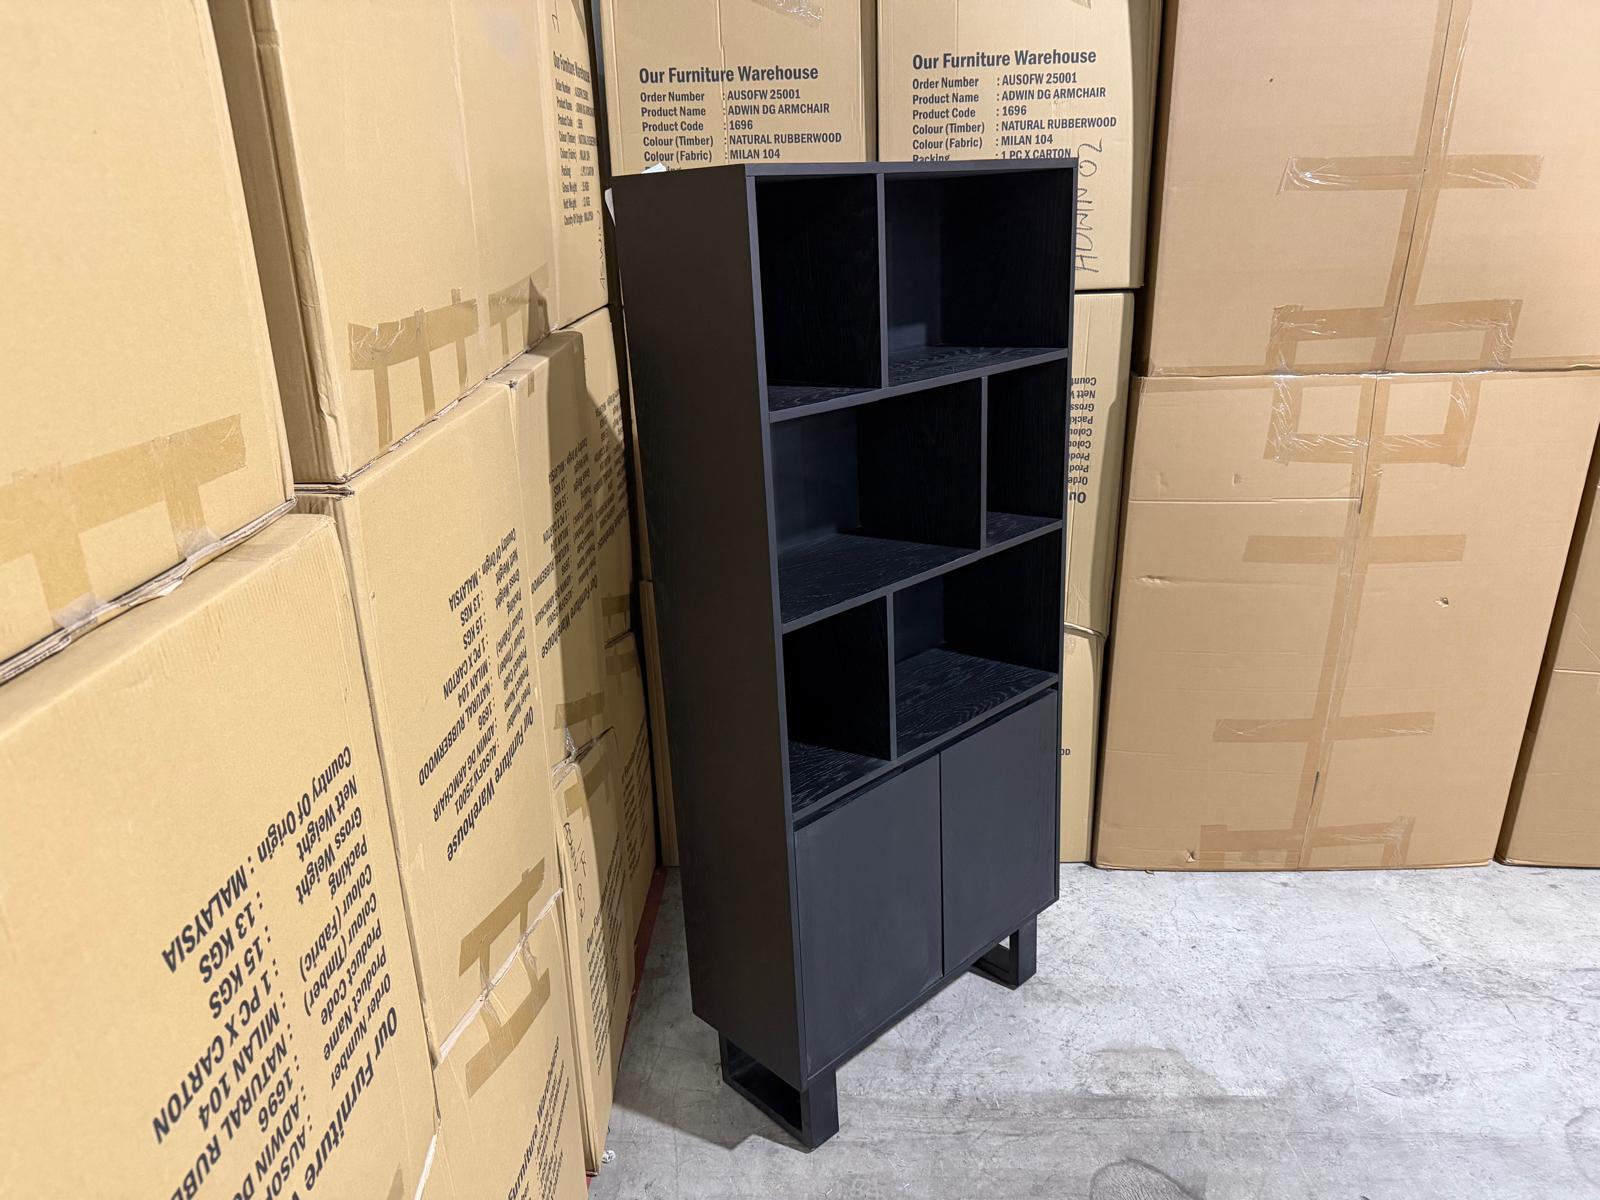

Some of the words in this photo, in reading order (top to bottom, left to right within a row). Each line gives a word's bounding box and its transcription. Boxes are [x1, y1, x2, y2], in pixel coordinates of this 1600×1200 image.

[639, 68, 665, 84] Our
[669, 65, 734, 84] Furniture
[738, 65, 818, 81] Warehouse
[913, 55, 939, 70] Our
[943, 52, 1010, 68] Furniture
[1014, 49, 1096, 65] Warehouse
[640, 92, 666, 102] Order
[668, 91, 704, 102] Number
[727, 89, 768, 101] AUSOFW
[770, 89, 800, 99] 25001
[913, 78, 939, 89] Order
[941, 77, 979, 88] Number
[1002, 73, 1044, 86] AUSOFW
[1046, 72, 1077, 84] 25001
[913, 93, 950, 105] Product
[952, 93, 979, 103] Name
[1002, 90, 1034, 101] ADWIN
[1037, 89, 1051, 99] DG
[1053, 87, 1106, 99] ARMCHAIR
[641, 107, 678, 117] Product
[680, 106, 706, 116] Name
[728, 105, 759, 115] ADWIN
[762, 104, 776, 114] DG
[778, 103, 829, 114] ARMCHAIR
[642, 121, 678, 132] Product
[680, 121, 703, 131] Code
[730, 119, 753, 130] 1696
[913, 108, 949, 120] Product
[952, 107, 975, 118] Code
[1003, 105, 1027, 116] 1696
[913, 124, 943, 135] Colour
[945, 122, 985, 136] (Timber)
[1002, 120, 1045, 131] NATURAL
[1048, 117, 1116, 129] RUBBERWOOD
[643, 136, 673, 146] Colour
[675, 136, 713, 148] (Timber)
[729, 134, 772, 145] NATURAL
[774, 133, 841, 144] RUBBERWOOD
[644, 151, 674, 163] Colour
[676, 150, 712, 164] (Fabric)
[730, 149, 760, 159] MILAN
[763, 148, 780, 159] 104
[913, 139, 943, 150] Colour
[945, 137, 982, 151] (Fabric)
[1001, 135, 1032, 146] MILAN
[1035, 134, 1053, 144] 104
[913, 153, 951, 162] Packing
[1001, 151, 1006, 159] 1
[1010, 150, 1022, 159] PC
[1025, 150, 1031, 159] X
[1033, 148, 1072, 159] CARTON
[1071, 377, 1096, 385] Coun
[1070, 403, 1094, 411] Gross
[1071, 416, 1093, 424] Pack
[1070, 428, 1092, 436] Colo
[1068, 477, 1088, 485] Orde
[1069, 492, 1086, 503] Ou
[448, 571, 479, 612] MALAYSIA
[473, 593, 480, 613] 13
[460, 602, 473, 627] KGS
[475, 616, 483, 635] 15
[463, 624, 476, 650] KGS
[473, 643, 481, 663] PC
[481, 637, 485, 653] 1
[443, 660, 468, 700] CARTON
[468, 653, 473, 670] X
[470, 659, 488, 692] MILAN
[458, 682, 470, 708] 104
[465, 680, 491, 723] NATURAL
[478, 701, 492, 731] 1696
[524, 706, 533, 733] Our
[419, 713, 465, 786] RUBBERWOOD
[476, 721, 494, 758] ADWIN
[494, 725, 524, 783] Furniture
[312, 746, 351, 802] Country
[467, 749, 476, 771] DG
[473, 742, 496, 786] AUSOFW
[297, 793, 311, 825] Of
[335, 774, 357, 815] Nett
[433, 761, 467, 822] ARMCHAIR
[454, 776, 474, 815] 25001
[257, 811, 296, 863] Origin
[296, 803, 336, 862] Weight
[334, 806, 362, 850] Gross
[447, 777, 495, 861] Warehouse
[296, 843, 335, 905] Weight
[328, 834, 367, 900] Packing
[343, 864, 372, 917] Colour
[162, 865, 248, 973] MALAYSIA
[235, 901, 255, 939] 13
[348, 892, 377, 946] Colour
[199, 927, 235, 983] KGS
[244, 936, 263, 976] 15
[300, 905, 341, 983] (Fabric)
[346, 918, 382, 986] Product
[209, 963, 243, 1019] KGS
[260, 970, 271, 996] 1
[304, 935, 347, 1017] (Timber)
[352, 945, 386, 1014] Product
[239, 985, 261, 1026] PC
[321, 978, 347, 1025] Code
[367, 973, 391, 1022] Order
[224, 1014, 239, 1047] X
[232, 1002, 280, 1082] MILAN
[323, 1005, 353, 1060] Name
[374, 1007, 397, 1060] Our
[331, 1015, 367, 1090] Number
[153, 1035, 224, 1144] CARTON
[198, 1072, 231, 1131] 104
[220, 1034, 287, 1140] NATURAL
[258, 1067, 293, 1133] 1696
[255, 1094, 299, 1182] ADWIN
[305, 1051, 374, 1191] Furniture
